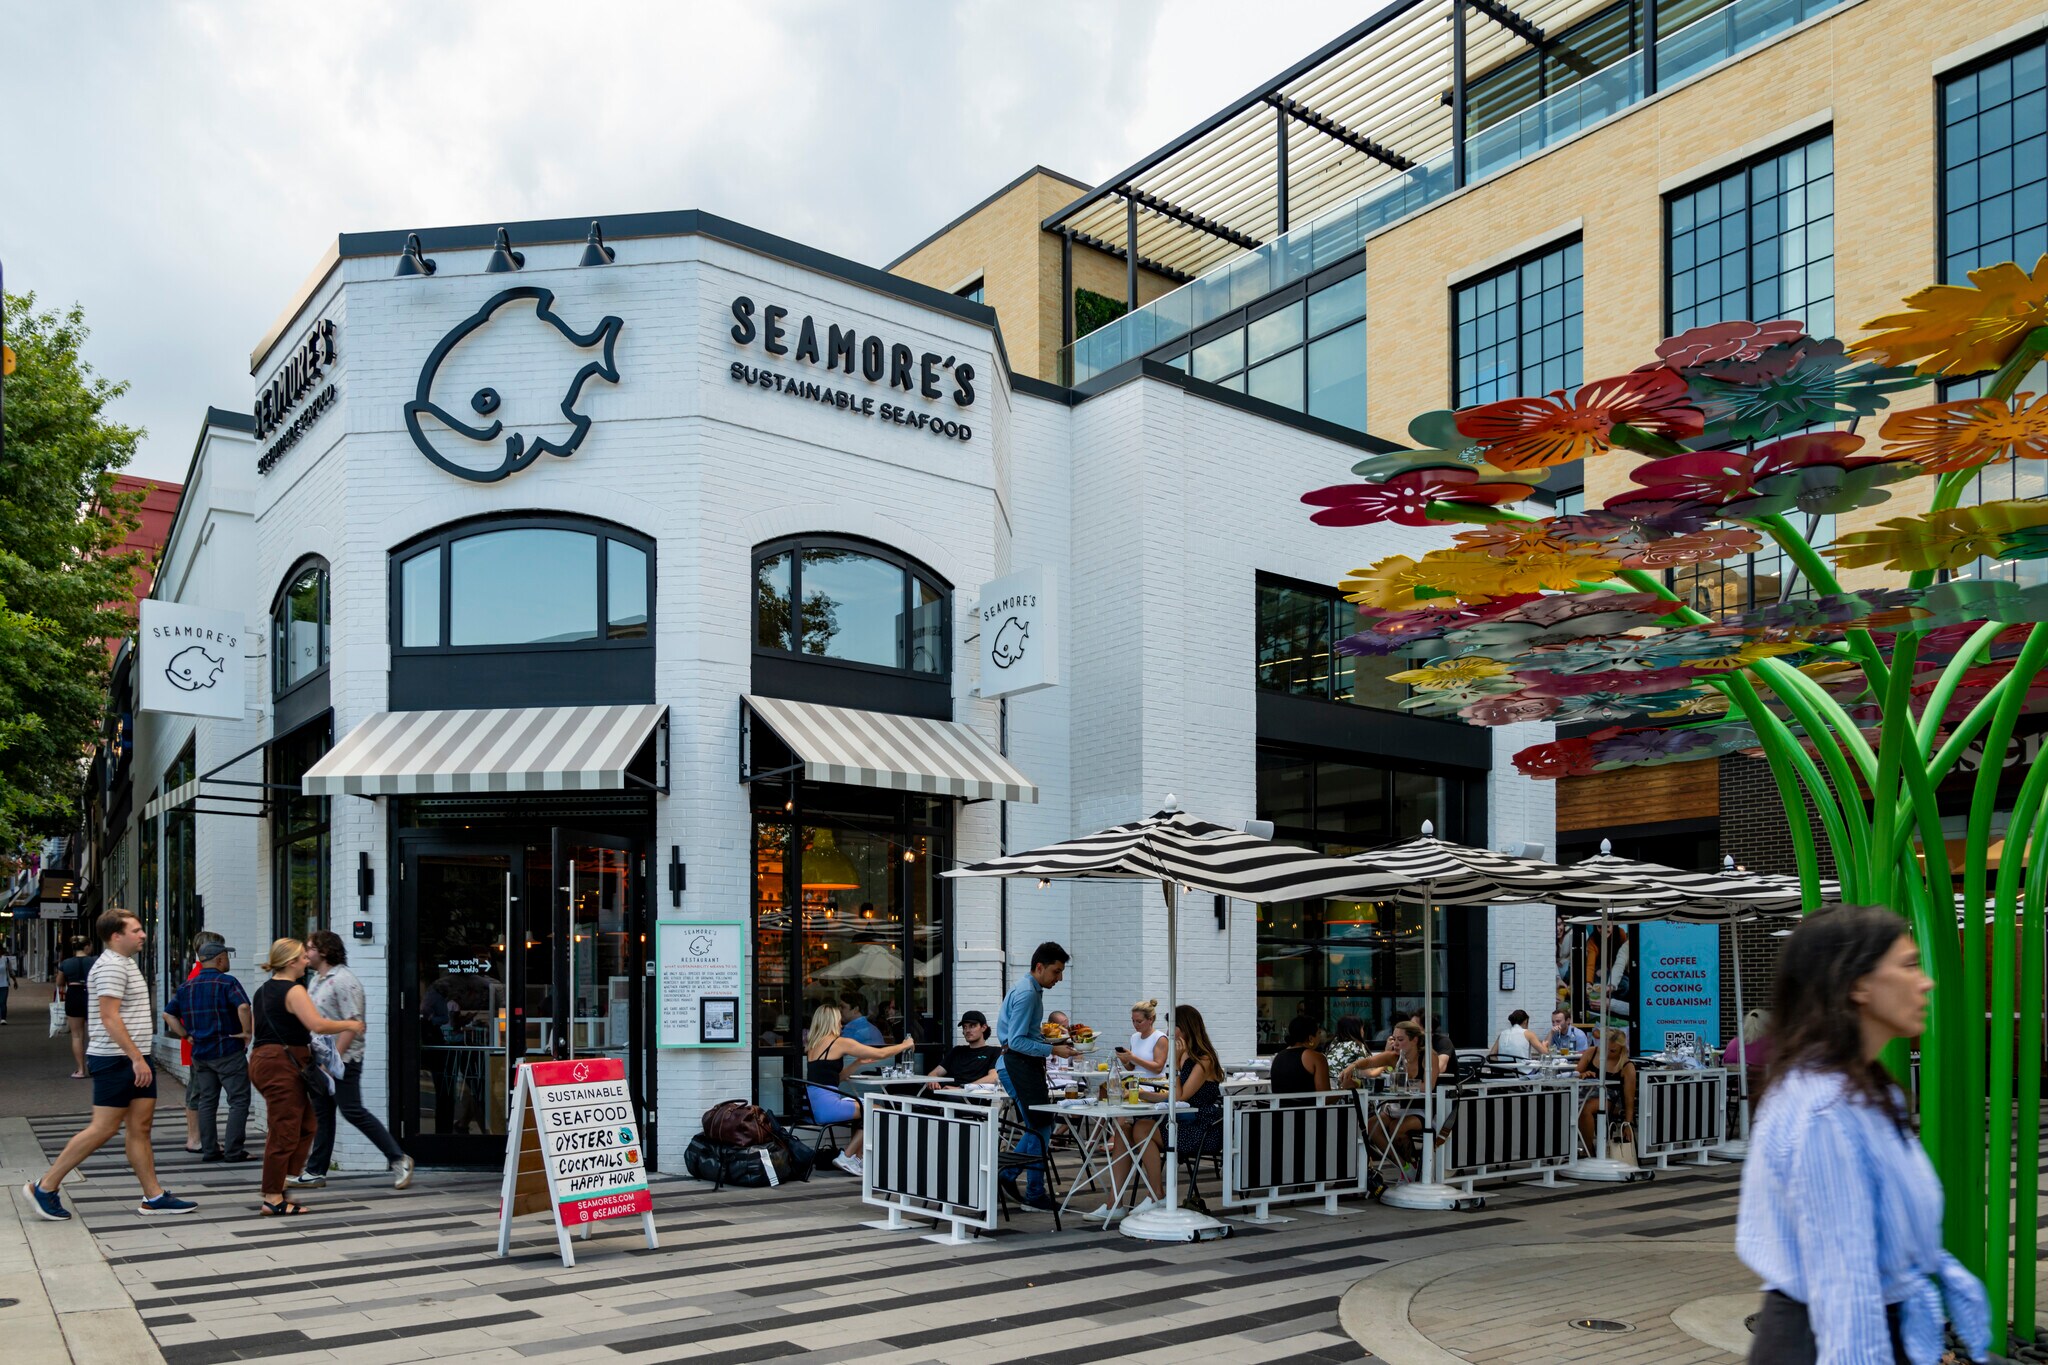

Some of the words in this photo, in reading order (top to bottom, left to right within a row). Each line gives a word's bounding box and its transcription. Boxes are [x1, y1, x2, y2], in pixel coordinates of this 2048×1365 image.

[731, 296, 975, 407] SEAMORE'S
[253, 318, 336, 440] SEAMORE'S
[730, 361, 875, 416] SUSTAINABLE
[880, 402, 972, 441] SEAFOOD
[984, 594, 1036, 621] SEAMORE'S
[153, 626, 236, 648] SEAMORE'S
[1660, 957, 1696, 965] COFFEE
[1651, 970, 1706, 979] COCKTAILS
[1654, 984, 1702, 992] COOKING
[1656, 998, 1712, 1006] CUBANISM!
[547, 1086, 624, 1102] SUSTAINABLE
[552, 1106, 627, 1126] SEAFOOD
[556, 1130, 613, 1152] OYSTERS
[559, 1152, 622, 1174] COCKTAILS
[570, 1174, 604, 1191] HAPPY
[609, 1171, 635, 1184] HOUR
[578, 1193, 634, 1209] SEAMORES.COM
[593, 1203, 636, 1219] @SEAMORES
